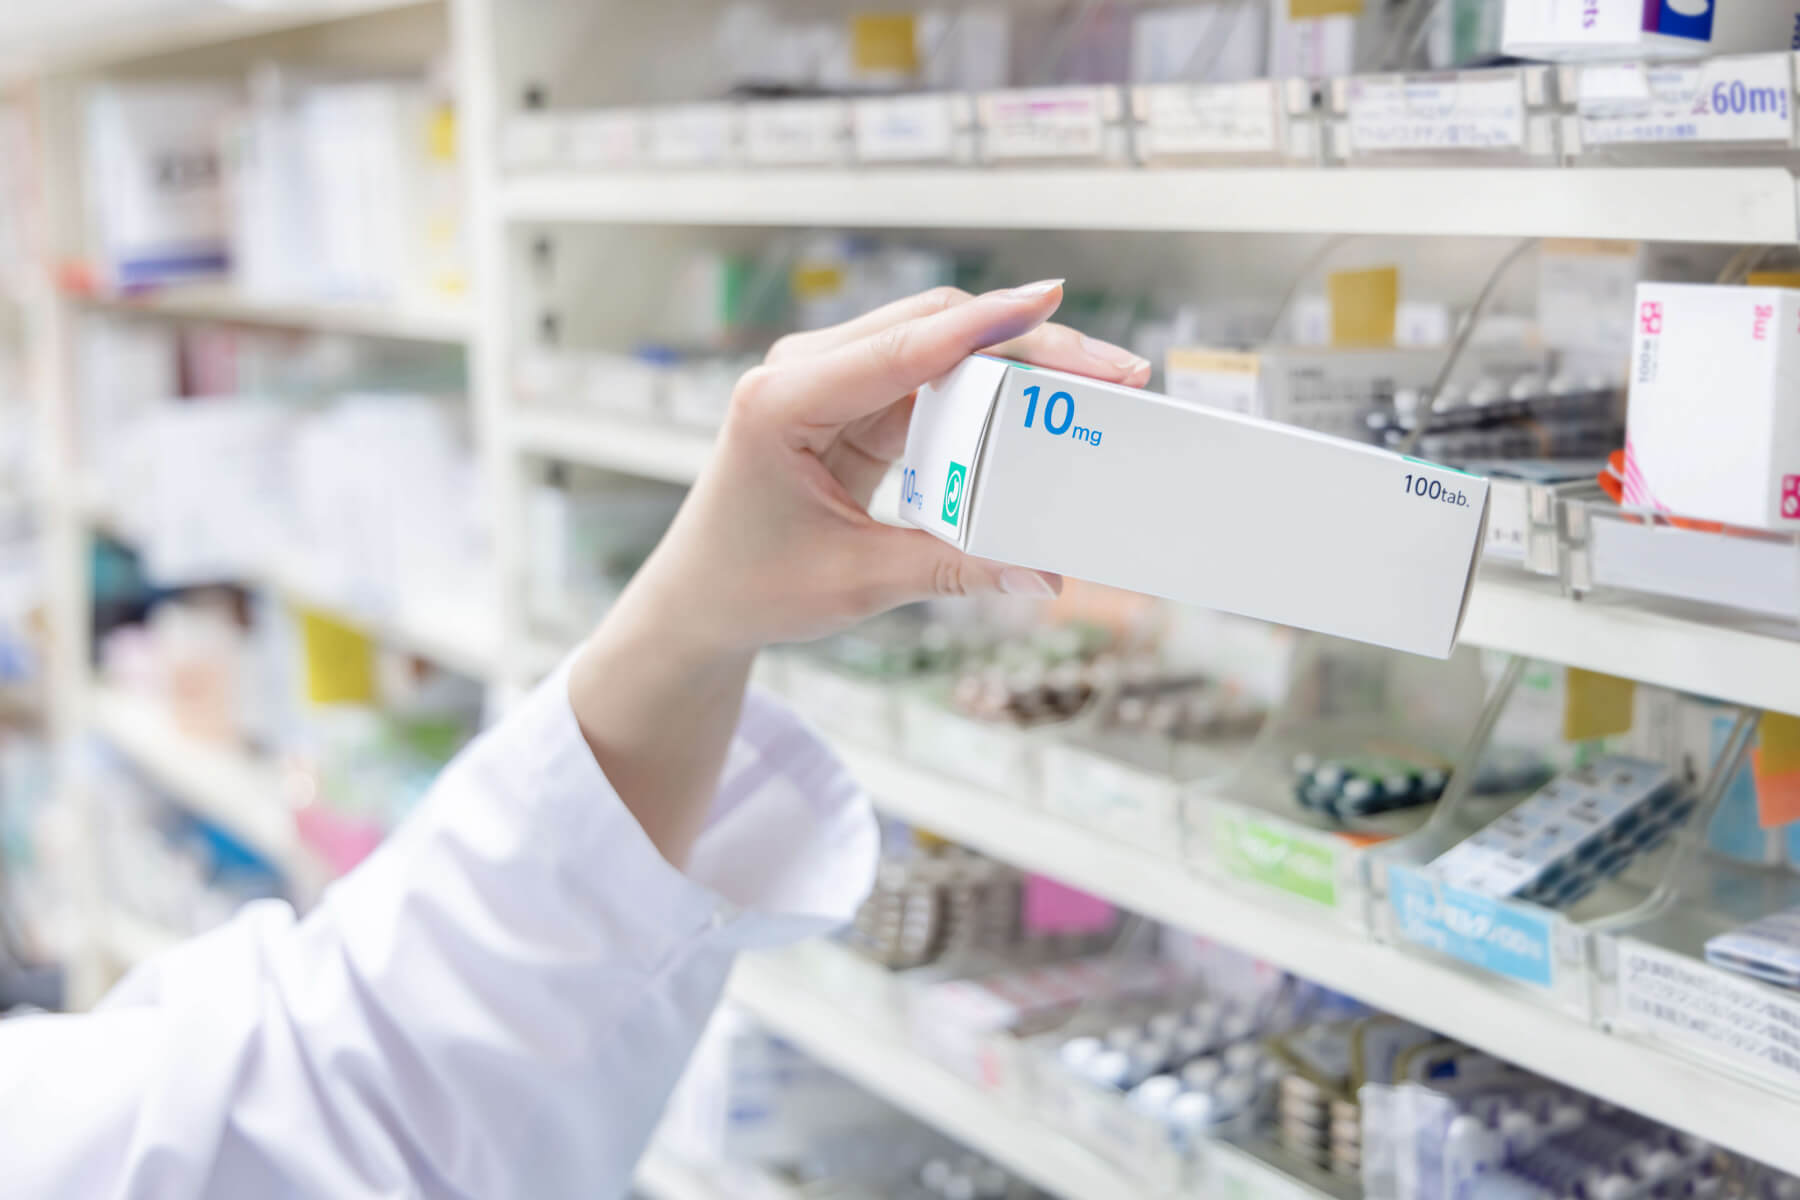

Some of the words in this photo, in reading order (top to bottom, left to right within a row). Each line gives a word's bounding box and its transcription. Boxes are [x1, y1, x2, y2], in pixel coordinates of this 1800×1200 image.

[1023, 385, 1103, 447] 10mg
[902, 466, 924, 511] 10mg
[1404, 474, 1470, 508] 100tab.
